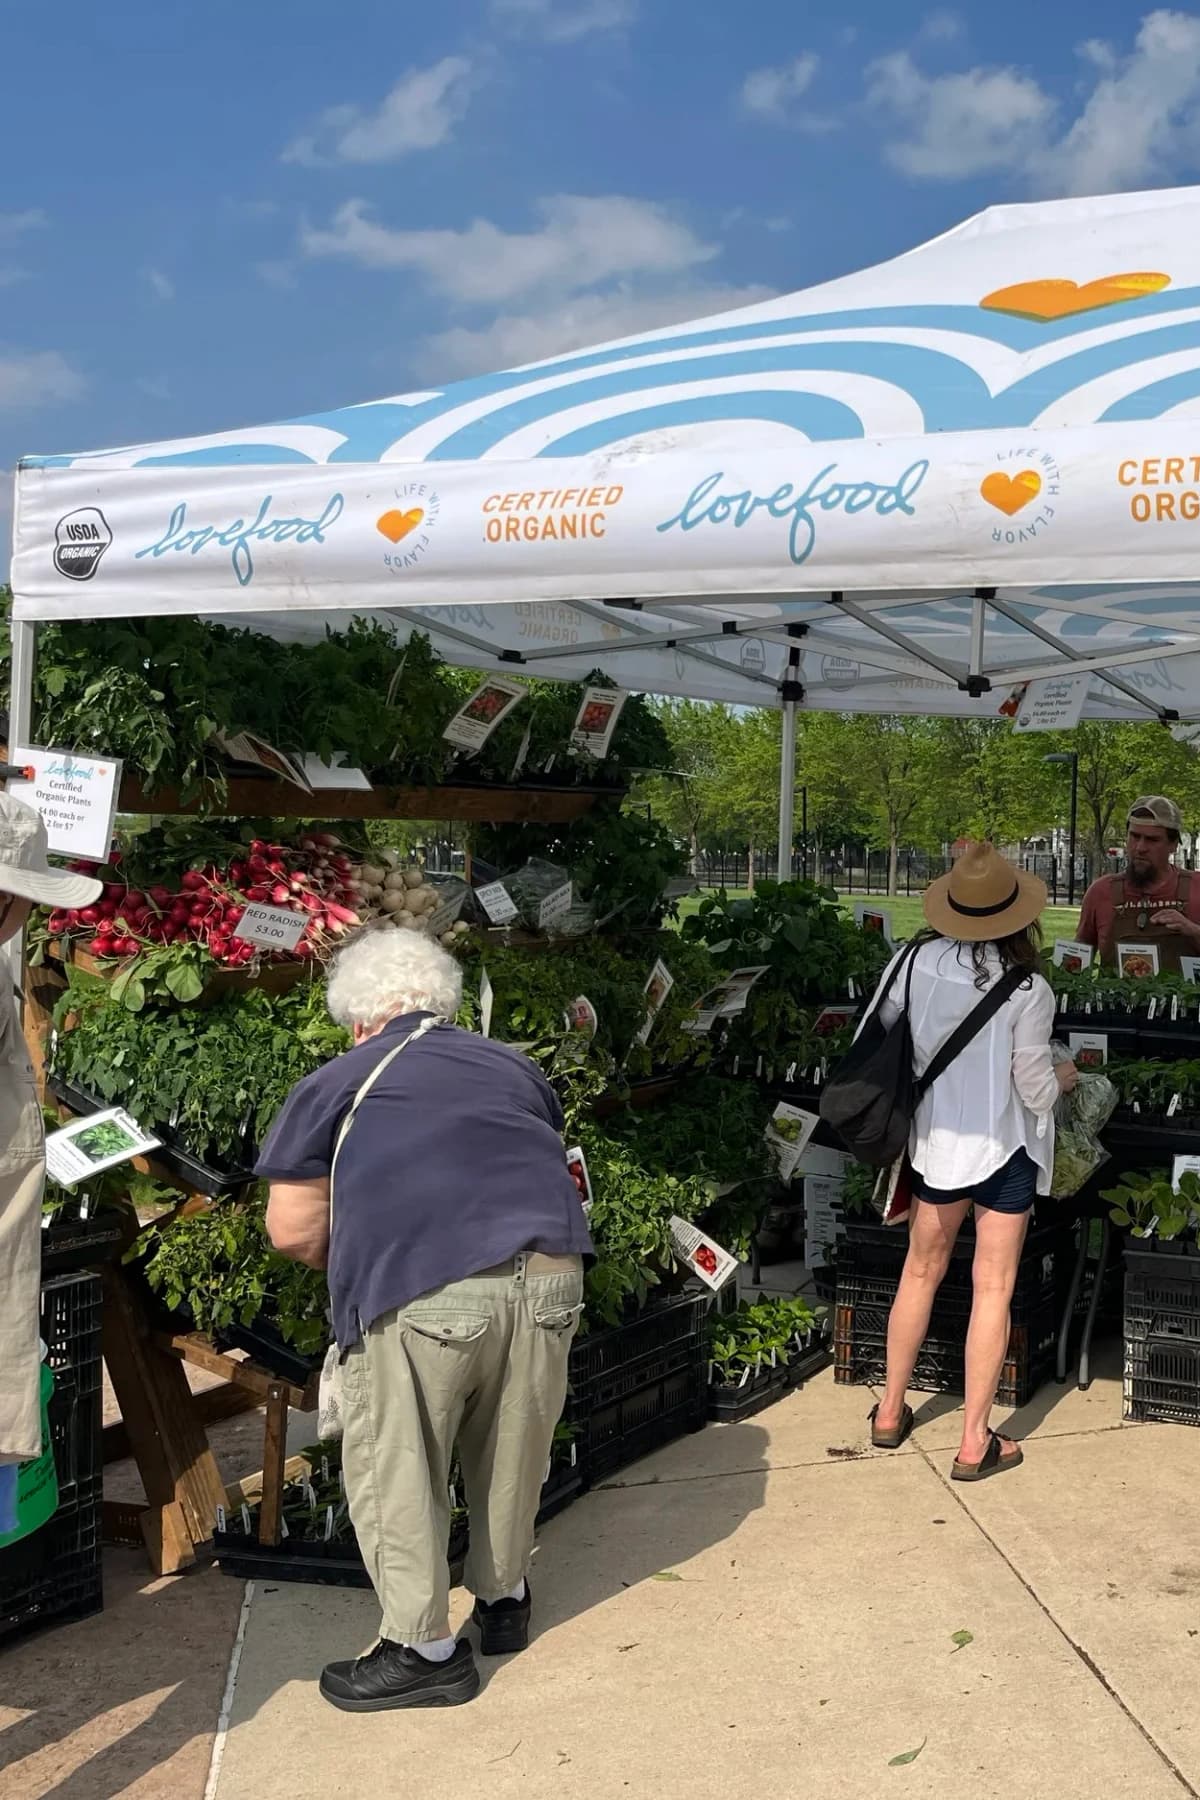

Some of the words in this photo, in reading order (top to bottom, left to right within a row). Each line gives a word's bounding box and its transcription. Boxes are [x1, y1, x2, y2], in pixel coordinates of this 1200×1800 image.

[996, 450, 1039, 462] LIFE
[1040, 453, 1060, 496] WITH
[394, 483, 427, 499] LIFE
[483, 486, 623, 513] CERTIFIED
[426, 491, 441, 527] WITH
[656, 459, 930, 564] lovefood
[66, 523, 100, 541] USDA
[487, 512, 606, 542] ORGANIC
[991, 505, 1055, 544] FLAVOR
[136, 493, 345, 585] lovefood
[61, 546, 100, 559] ORGANIC
[383, 534, 430, 568] FLAVOR
[49, 780, 83, 793] Certified
[36, 790, 66, 804] Organic
[68, 795, 92, 808] Plants
[39, 806, 58, 817] $4.00
[59, 811, 76, 821] each
[47, 820, 51, 828] 2
[53, 821, 64, 829] for
[246, 908, 267, 920] RED
[269, 914, 306, 929] RADISH
[255, 924, 285, 938] $3.00
